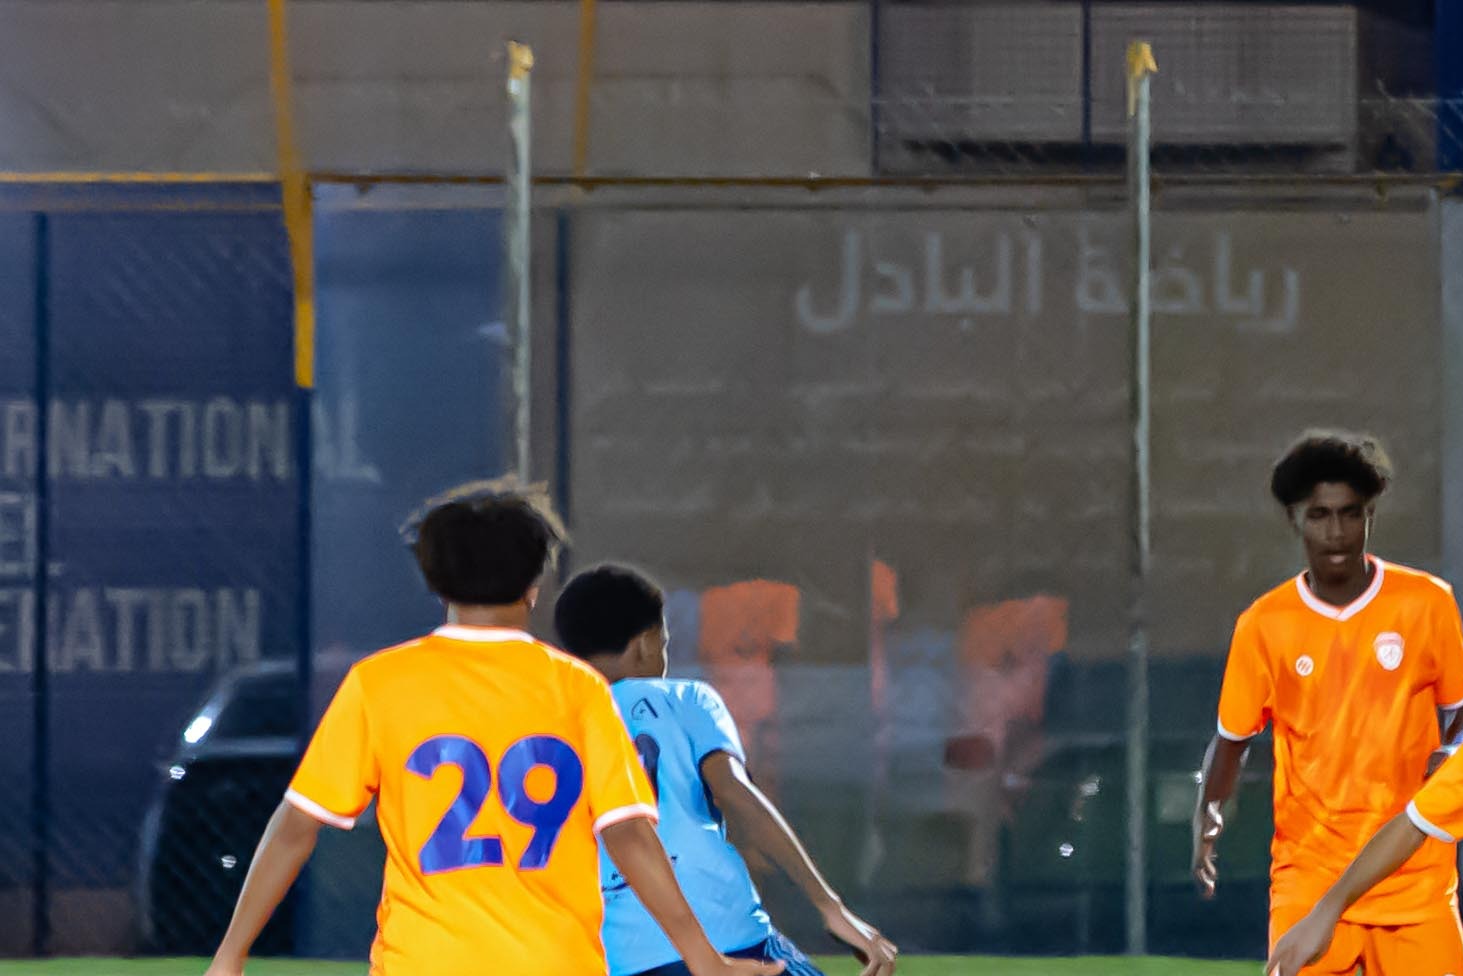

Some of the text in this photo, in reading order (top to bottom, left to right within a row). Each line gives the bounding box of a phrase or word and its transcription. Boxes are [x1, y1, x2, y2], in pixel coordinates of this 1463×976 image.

[798, 229, 1298, 333] رياضة البادل
[404, 732, 585, 876] 29
